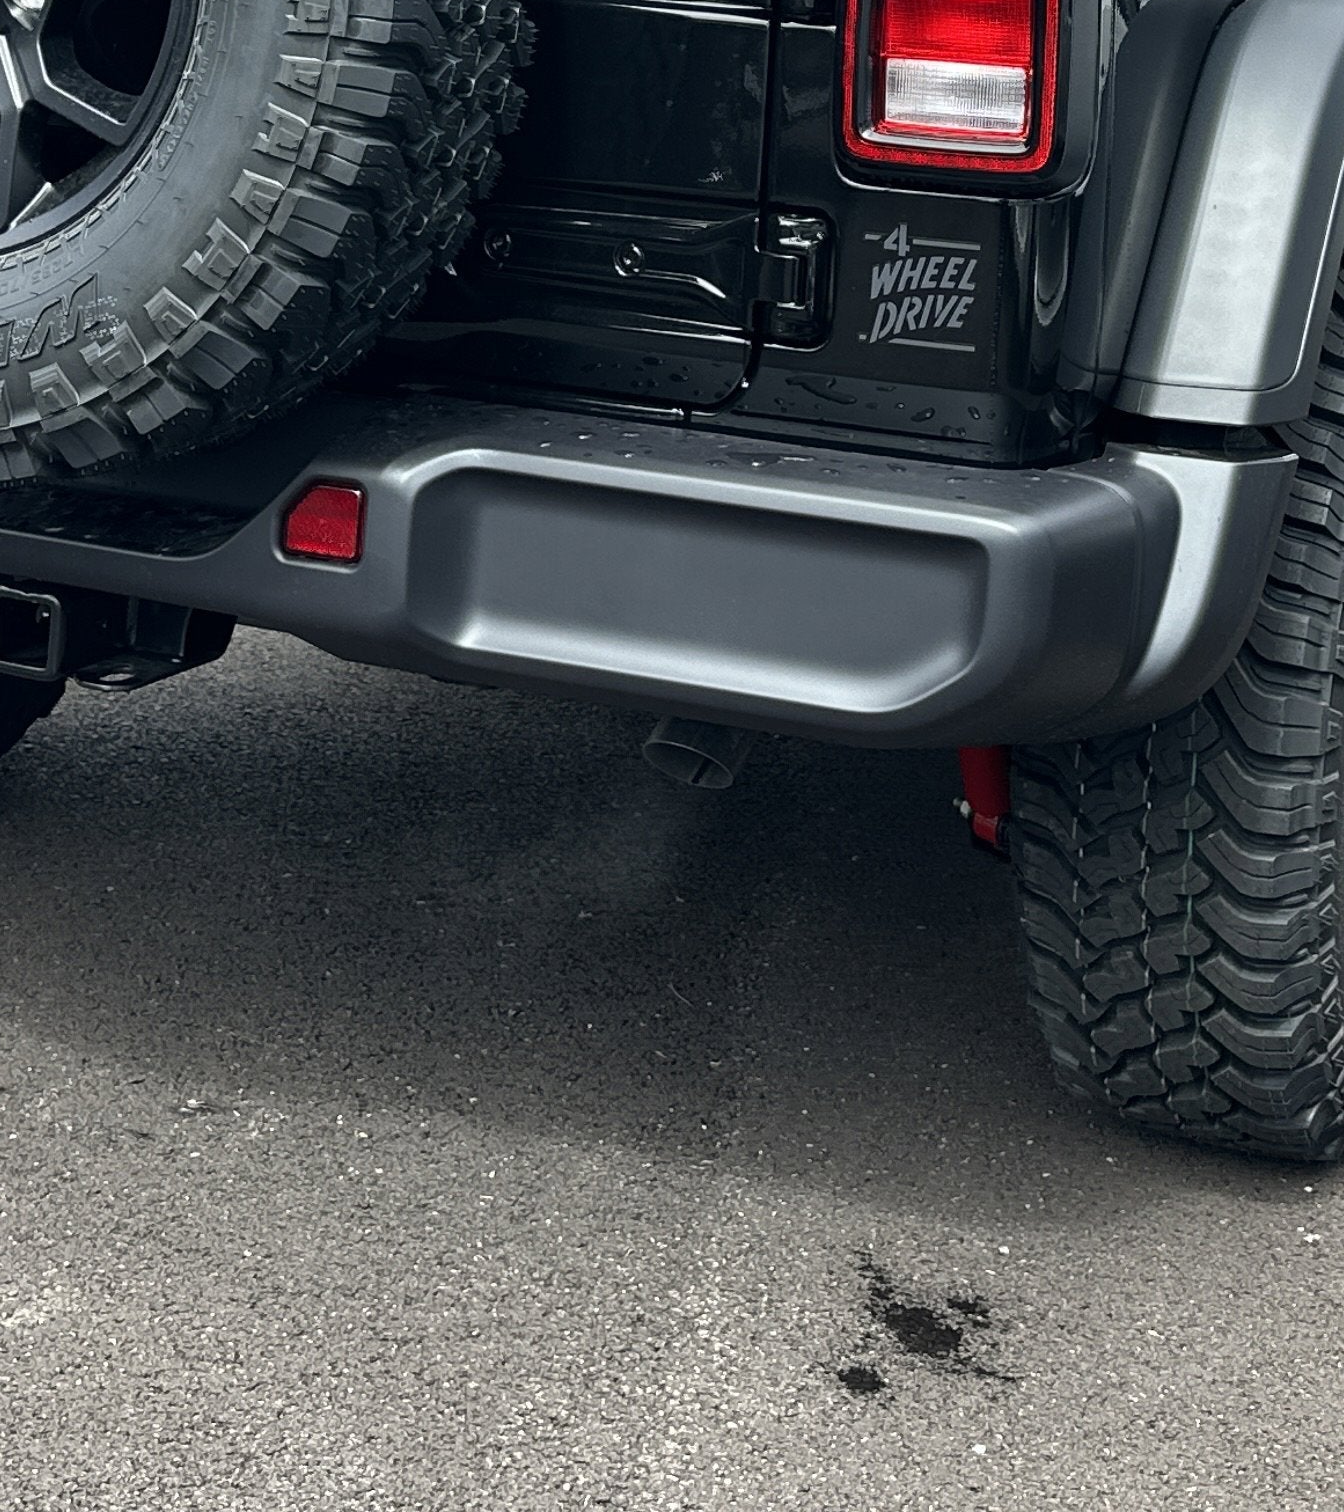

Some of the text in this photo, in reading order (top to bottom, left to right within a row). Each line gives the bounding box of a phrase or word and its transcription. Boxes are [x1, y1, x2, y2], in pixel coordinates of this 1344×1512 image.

[883, 223, 910, 257] 4
[870, 256, 978, 300] WHEEL
[869, 294, 975, 344] DRIVE
